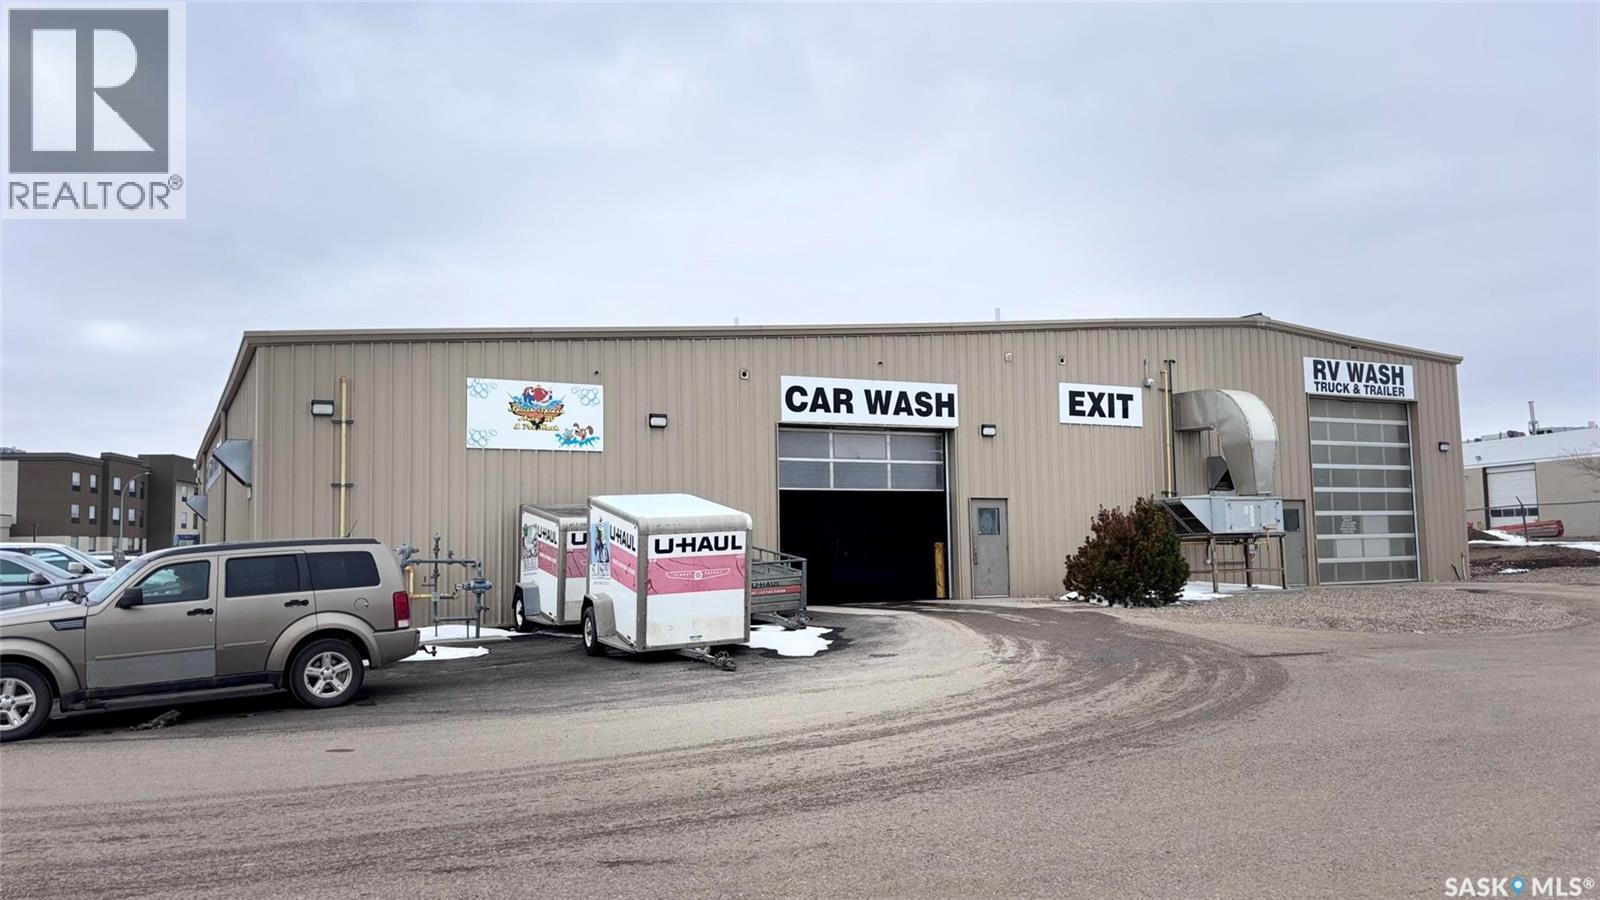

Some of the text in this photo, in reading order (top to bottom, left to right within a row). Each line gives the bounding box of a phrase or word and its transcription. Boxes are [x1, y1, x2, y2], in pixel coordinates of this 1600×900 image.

[1313, 359, 1405, 386] RV WASH
[785, 385, 956, 418] CAR WASH
[1314, 381, 1405, 397] TRUCK & TRAILER
[1068, 390, 1134, 419] EXIT
[610, 524, 636, 552] U-HAUL
[654, 535, 742, 554] U-HAUL
